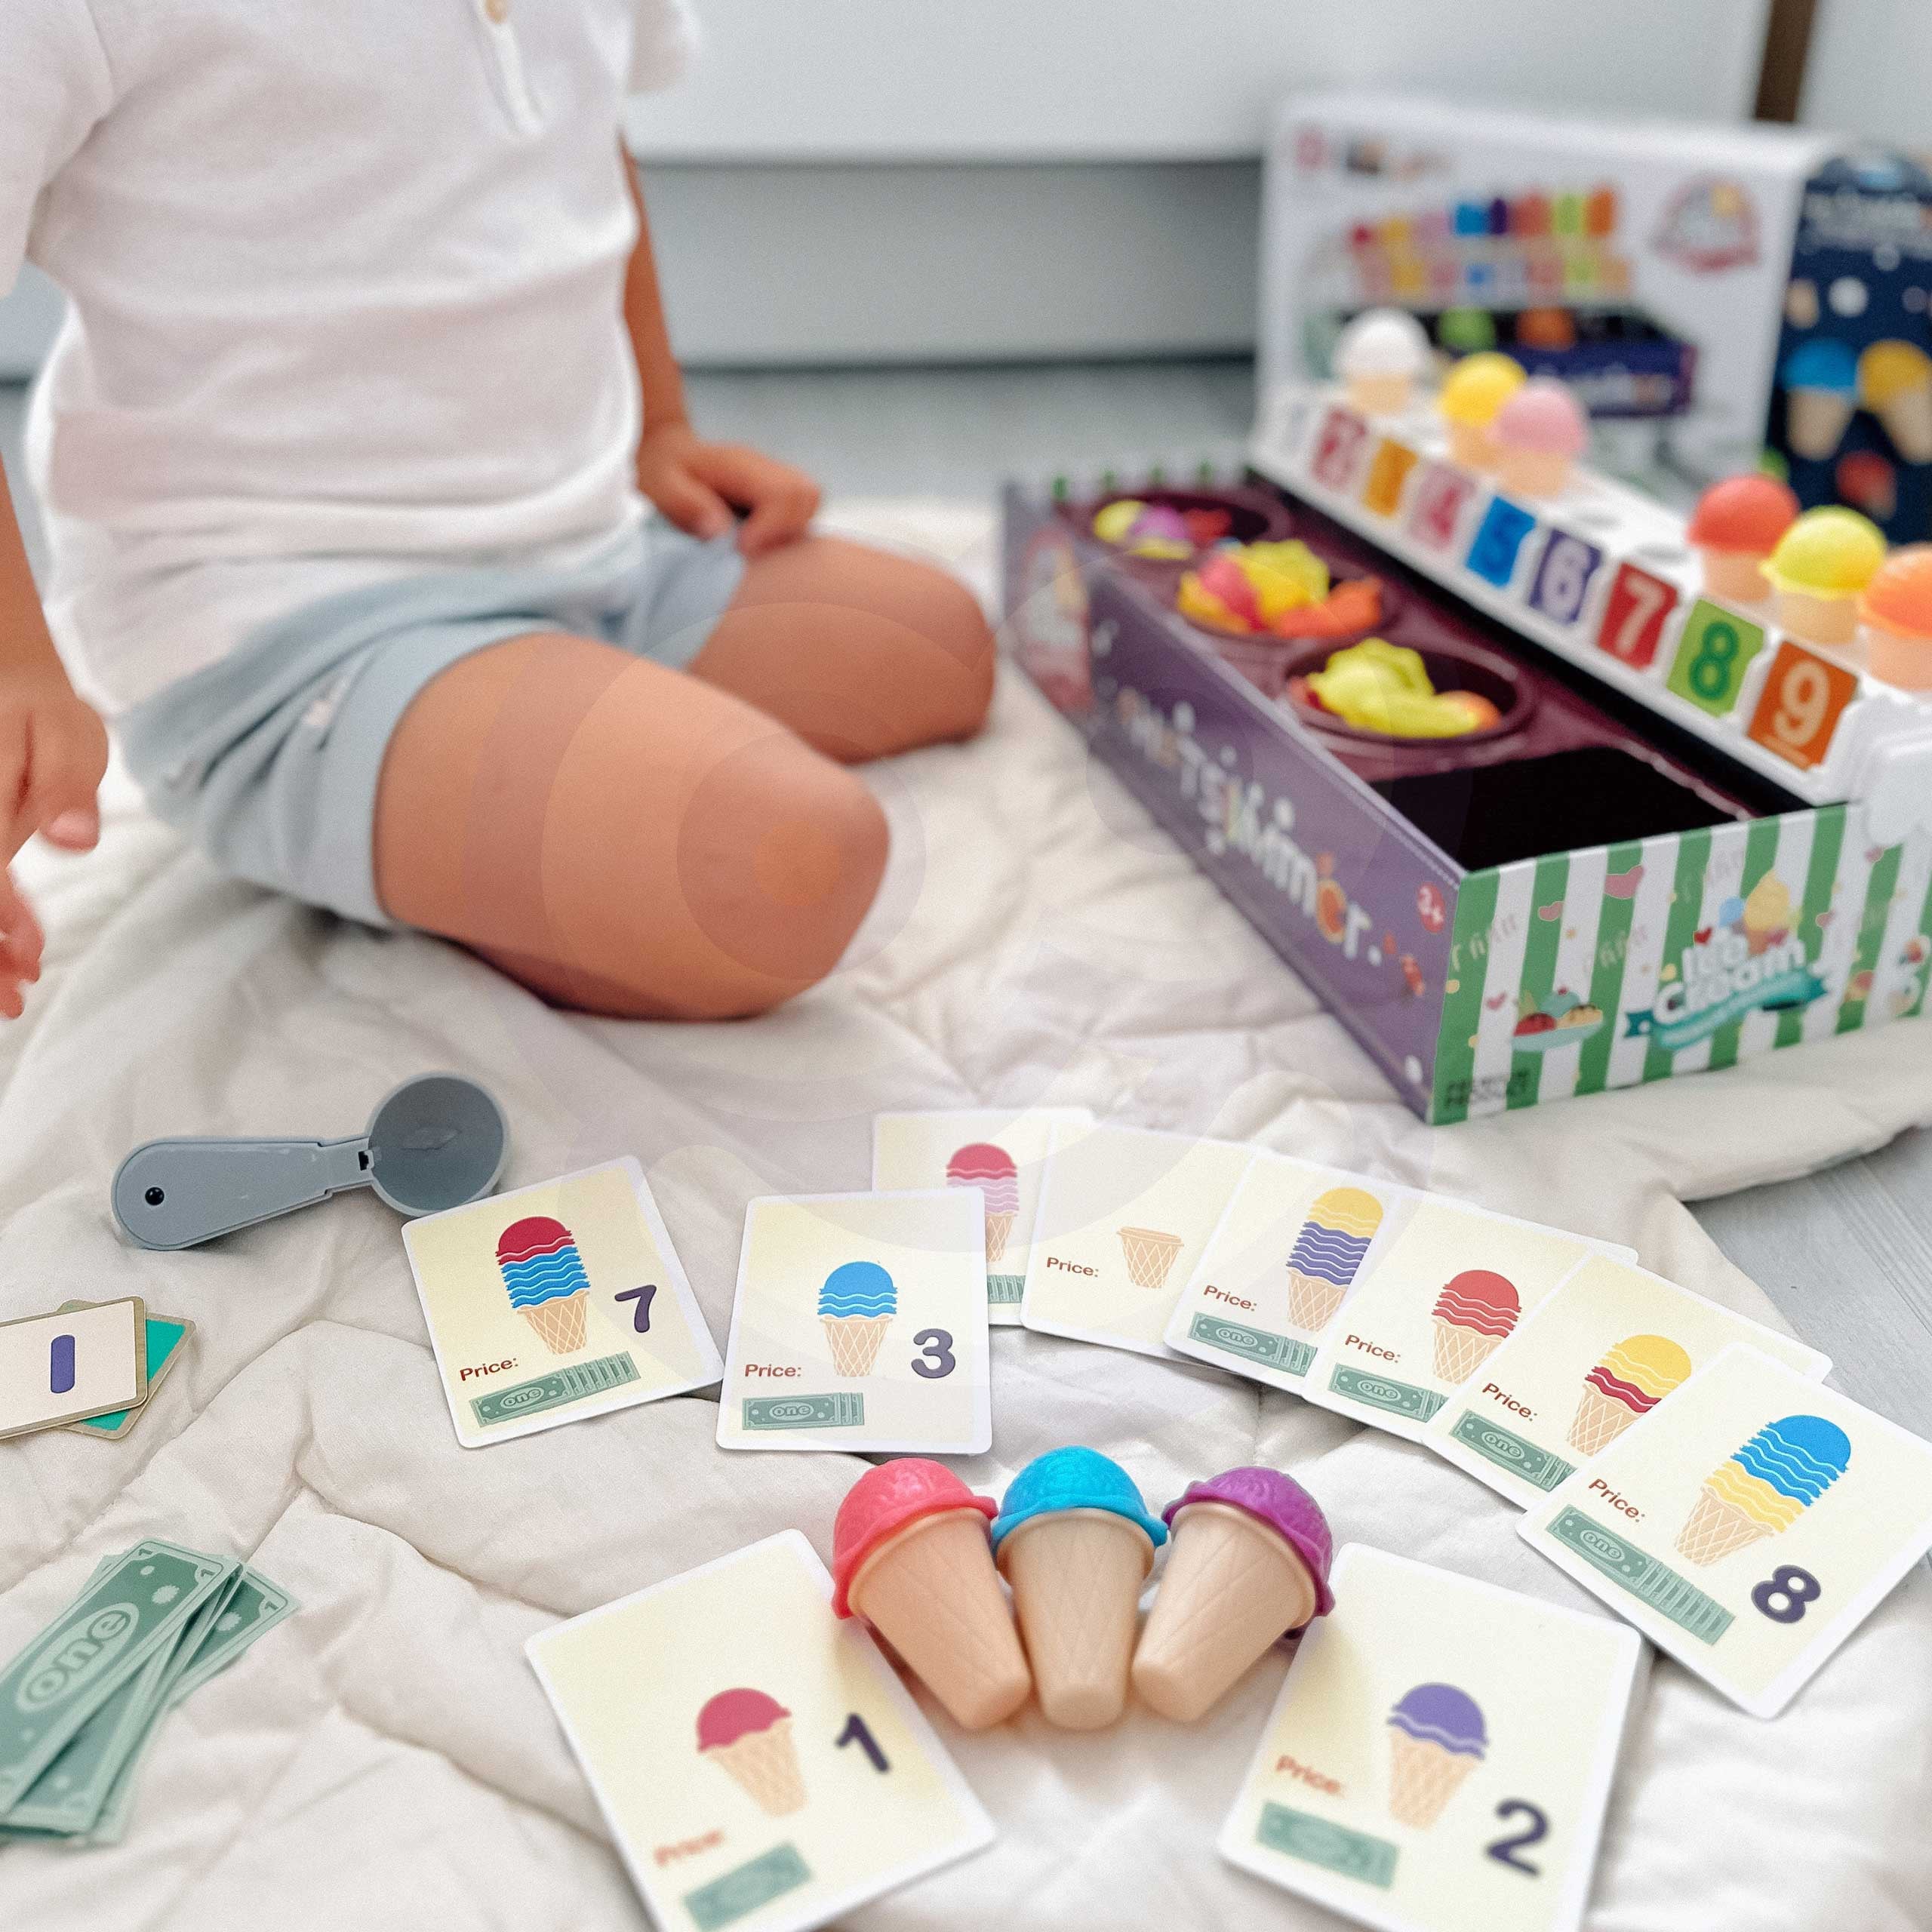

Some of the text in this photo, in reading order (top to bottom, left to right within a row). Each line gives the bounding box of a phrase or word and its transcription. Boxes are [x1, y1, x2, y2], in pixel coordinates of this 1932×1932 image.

[1540, 532, 1590, 622] 6
[1616, 574, 1666, 654] 7
[1687, 622, 1739, 700] 8
[1774, 660, 1829, 746] 9
[1047, 1257, 1100, 1278] Price:
[614, 1284, 657, 1334] 7
[1203, 1284, 1257, 1312] Price:
[911, 1328, 956, 1379] 3
[1218, 1328, 1256, 1346] one
[1345, 1334, 1401, 1364] Price:
[460, 1357, 519, 1382] Price:
[744, 1364, 802, 1377] Price:
[503, 1389, 542, 1407] one
[772, 1405, 811, 1417] one
[1359, 1382, 1398, 1400] one
[1482, 1383, 1538, 1422] Price:
[1484, 1433, 1522, 1458] one
[1588, 1478, 1645, 1523] Price:
[1751, 1564, 1822, 1624] 8
[25, 1609, 131, 1703] one
[835, 1712, 891, 1774] 1
[1484, 1796, 1551, 1878] 2
